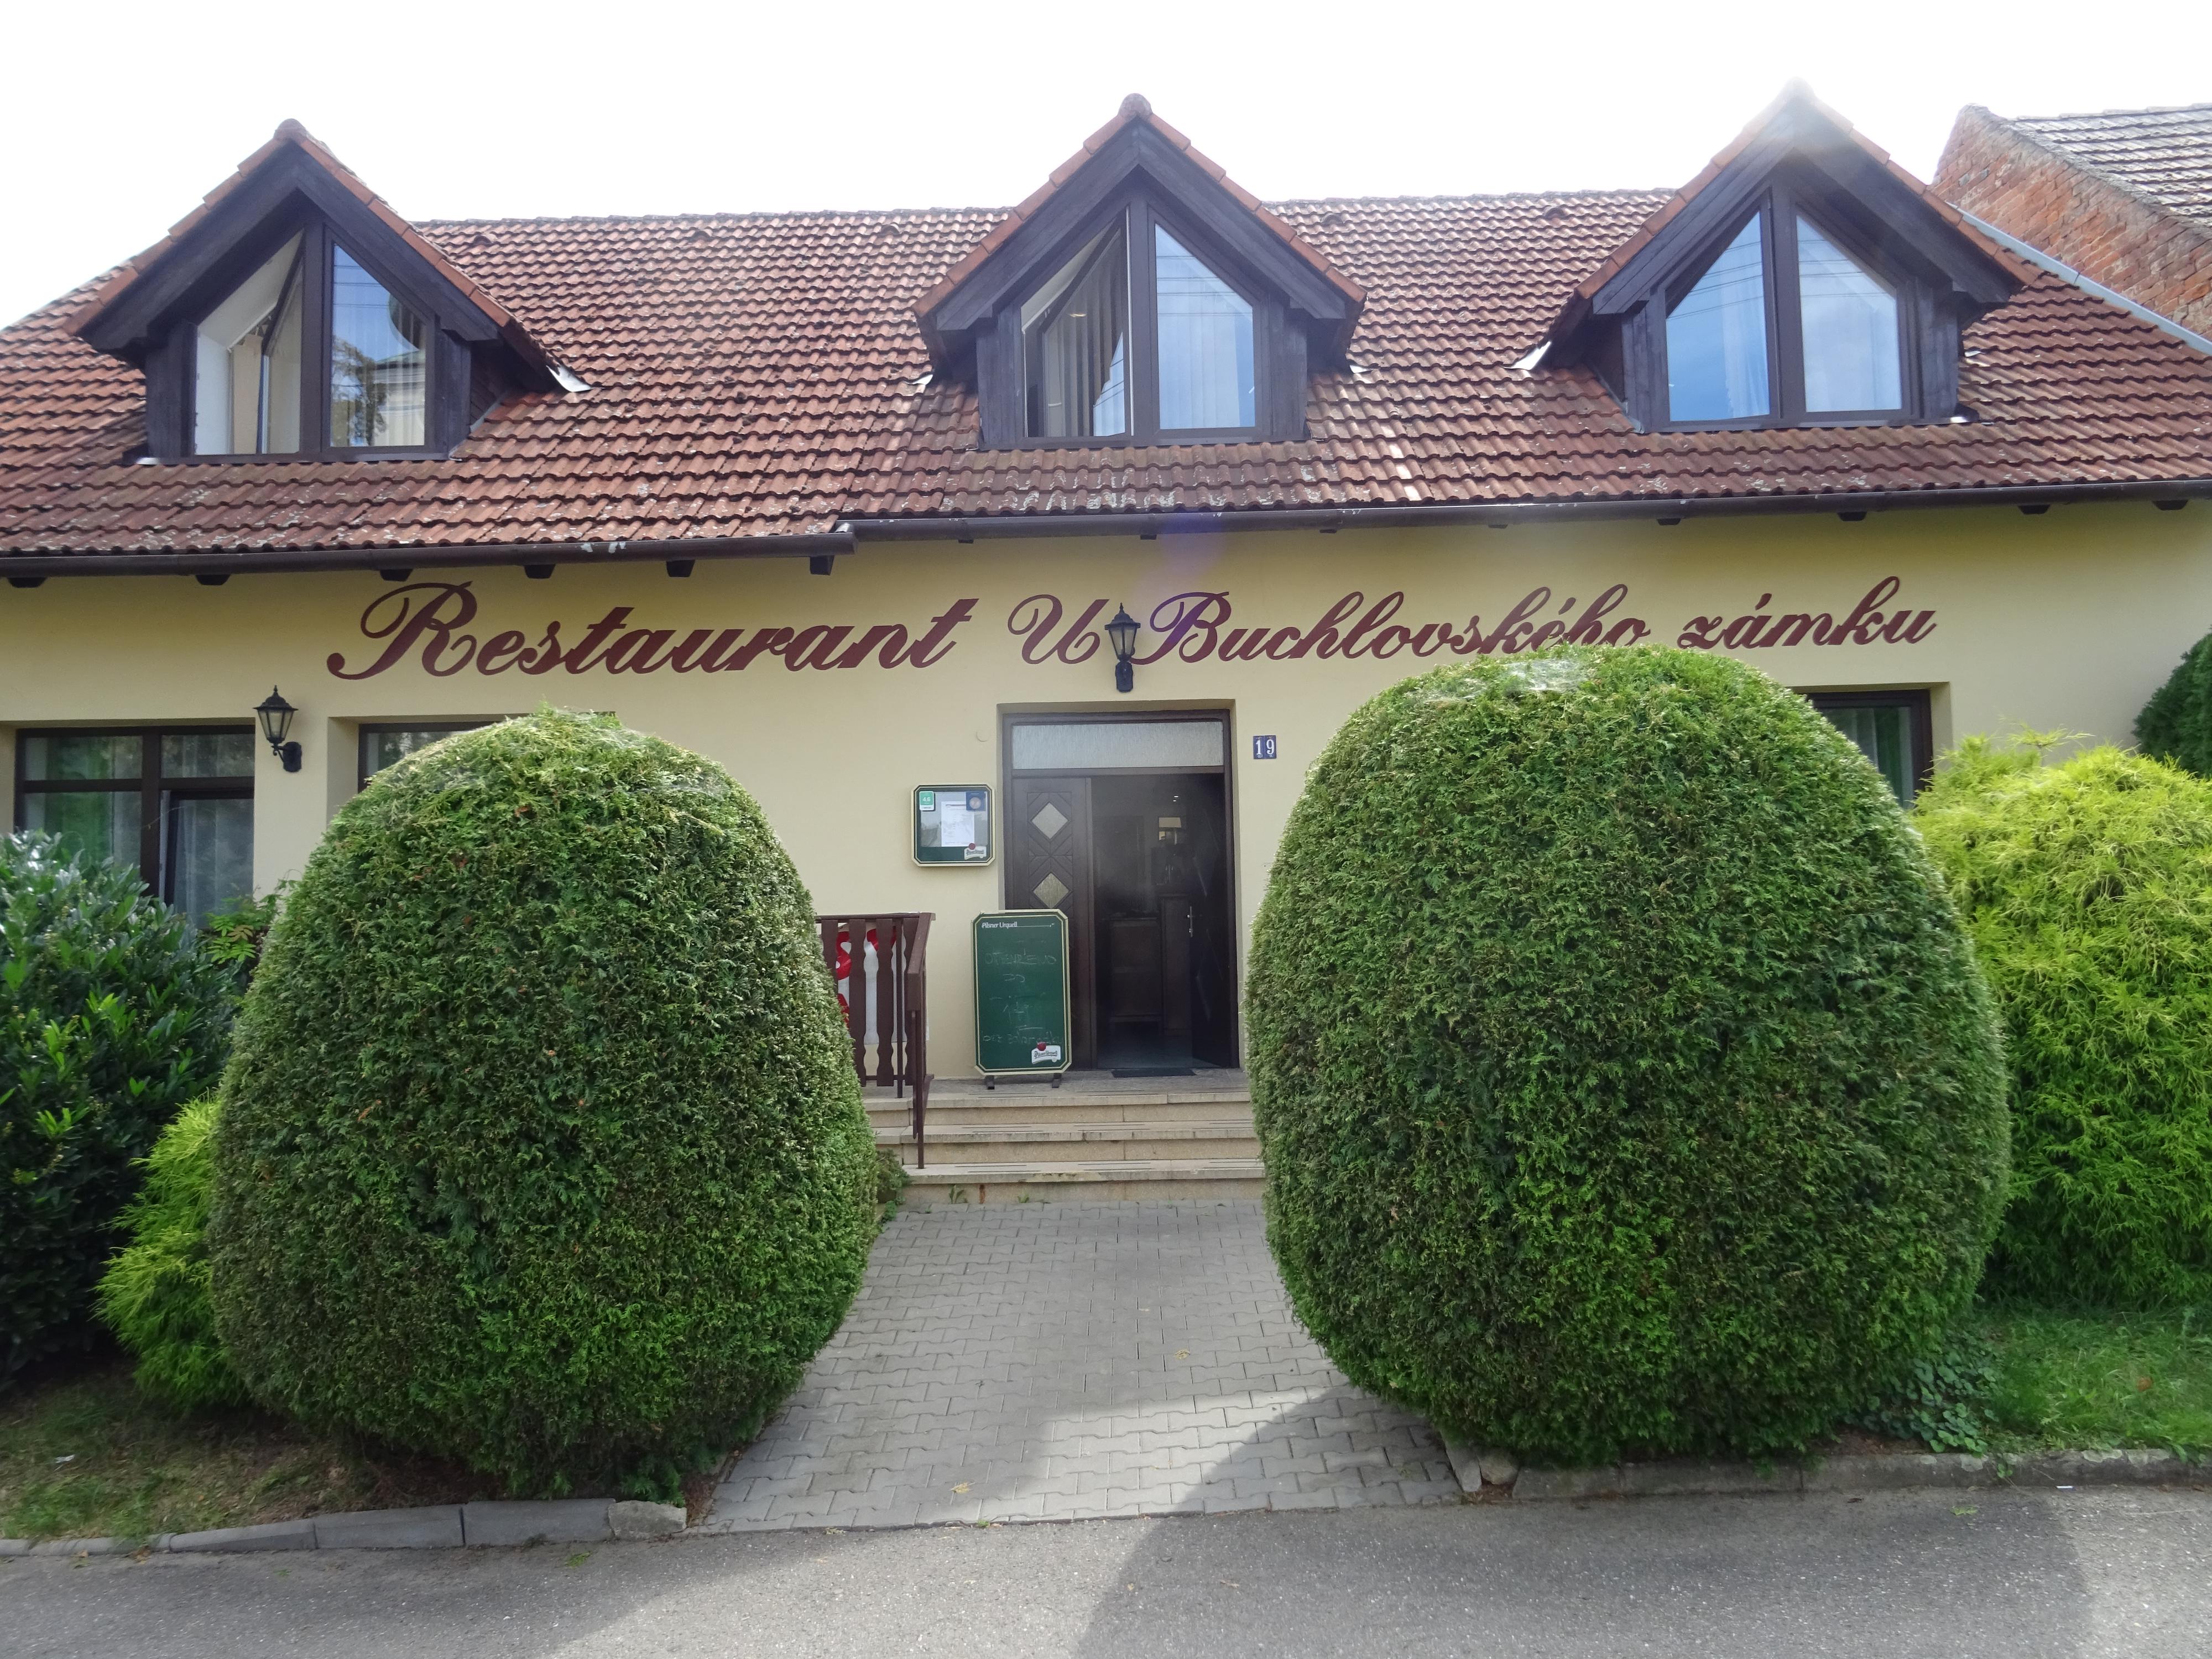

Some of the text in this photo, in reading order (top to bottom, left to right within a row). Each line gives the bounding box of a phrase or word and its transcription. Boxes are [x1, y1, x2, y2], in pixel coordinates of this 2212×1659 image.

[326, 576, 1938, 680] Restaurant U Buchlovského zámku
[1255, 739, 1274, 755] 19
